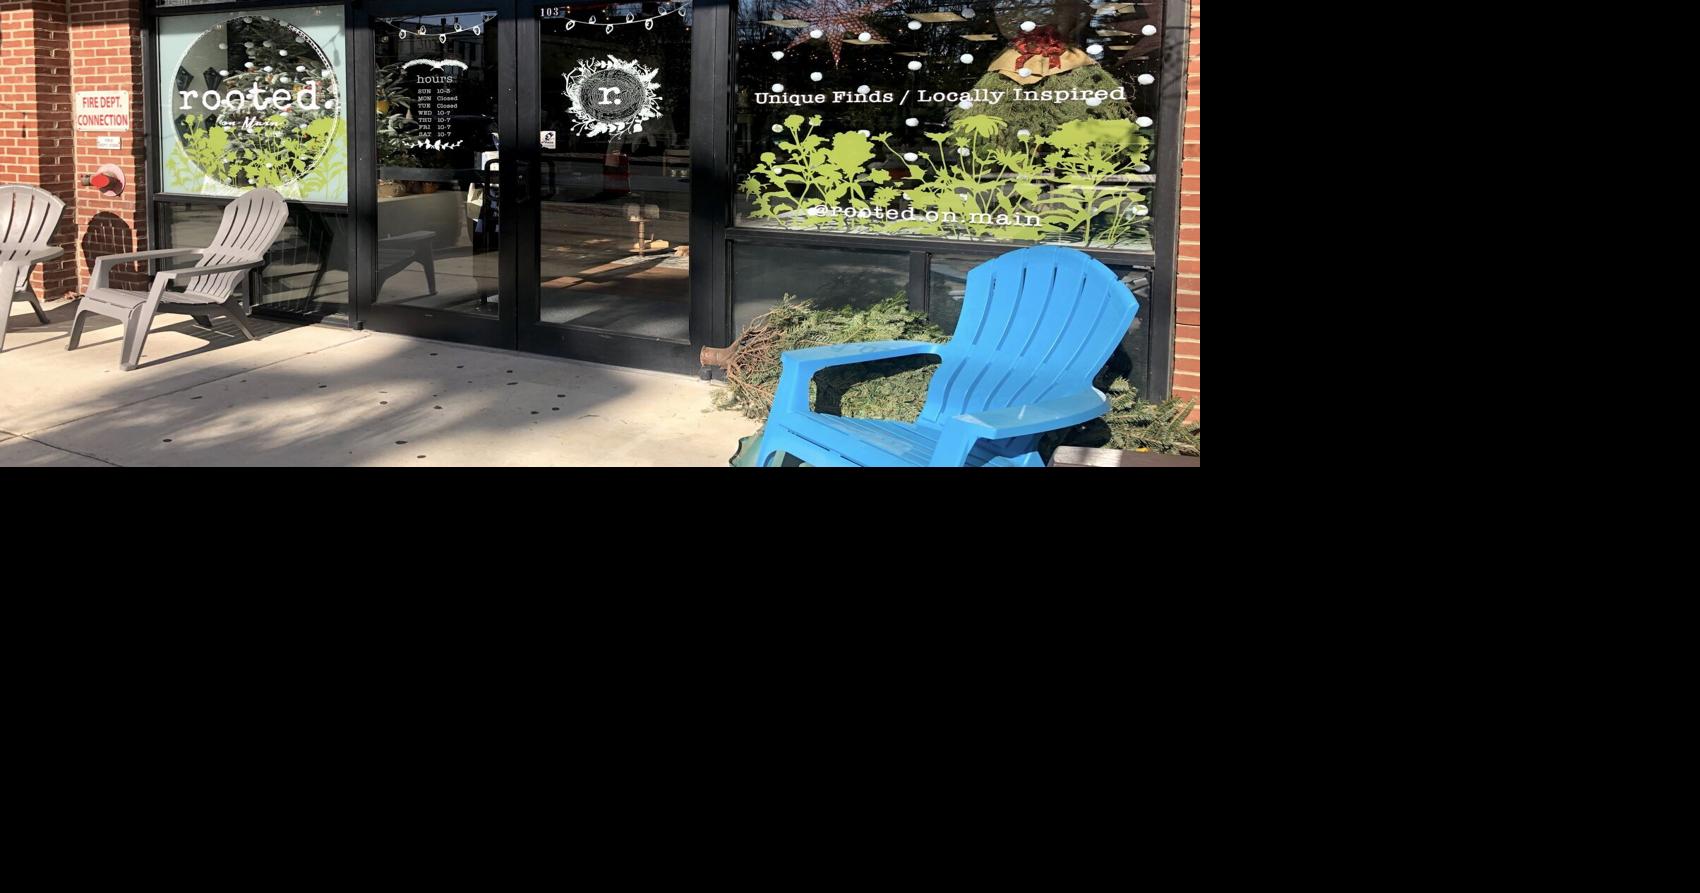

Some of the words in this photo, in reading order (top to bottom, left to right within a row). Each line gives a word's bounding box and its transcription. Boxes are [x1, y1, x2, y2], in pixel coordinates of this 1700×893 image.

[541, 7, 558, 16] 103
[416, 75, 453, 84] hours
[178, 80, 335, 111] rooted.
[598, 86, 621, 105] r.
[754, 92, 826, 106] Unique
[832, 90, 894, 104] Finds
[899, 89, 910, 106] /
[917, 88, 1005, 105] Locally
[1013, 86, 1126, 104] Inspired
[82, 96, 99, 108] FIRE
[100, 96, 122, 108] DEPT.
[77, 114, 128, 126] CONNECTION
